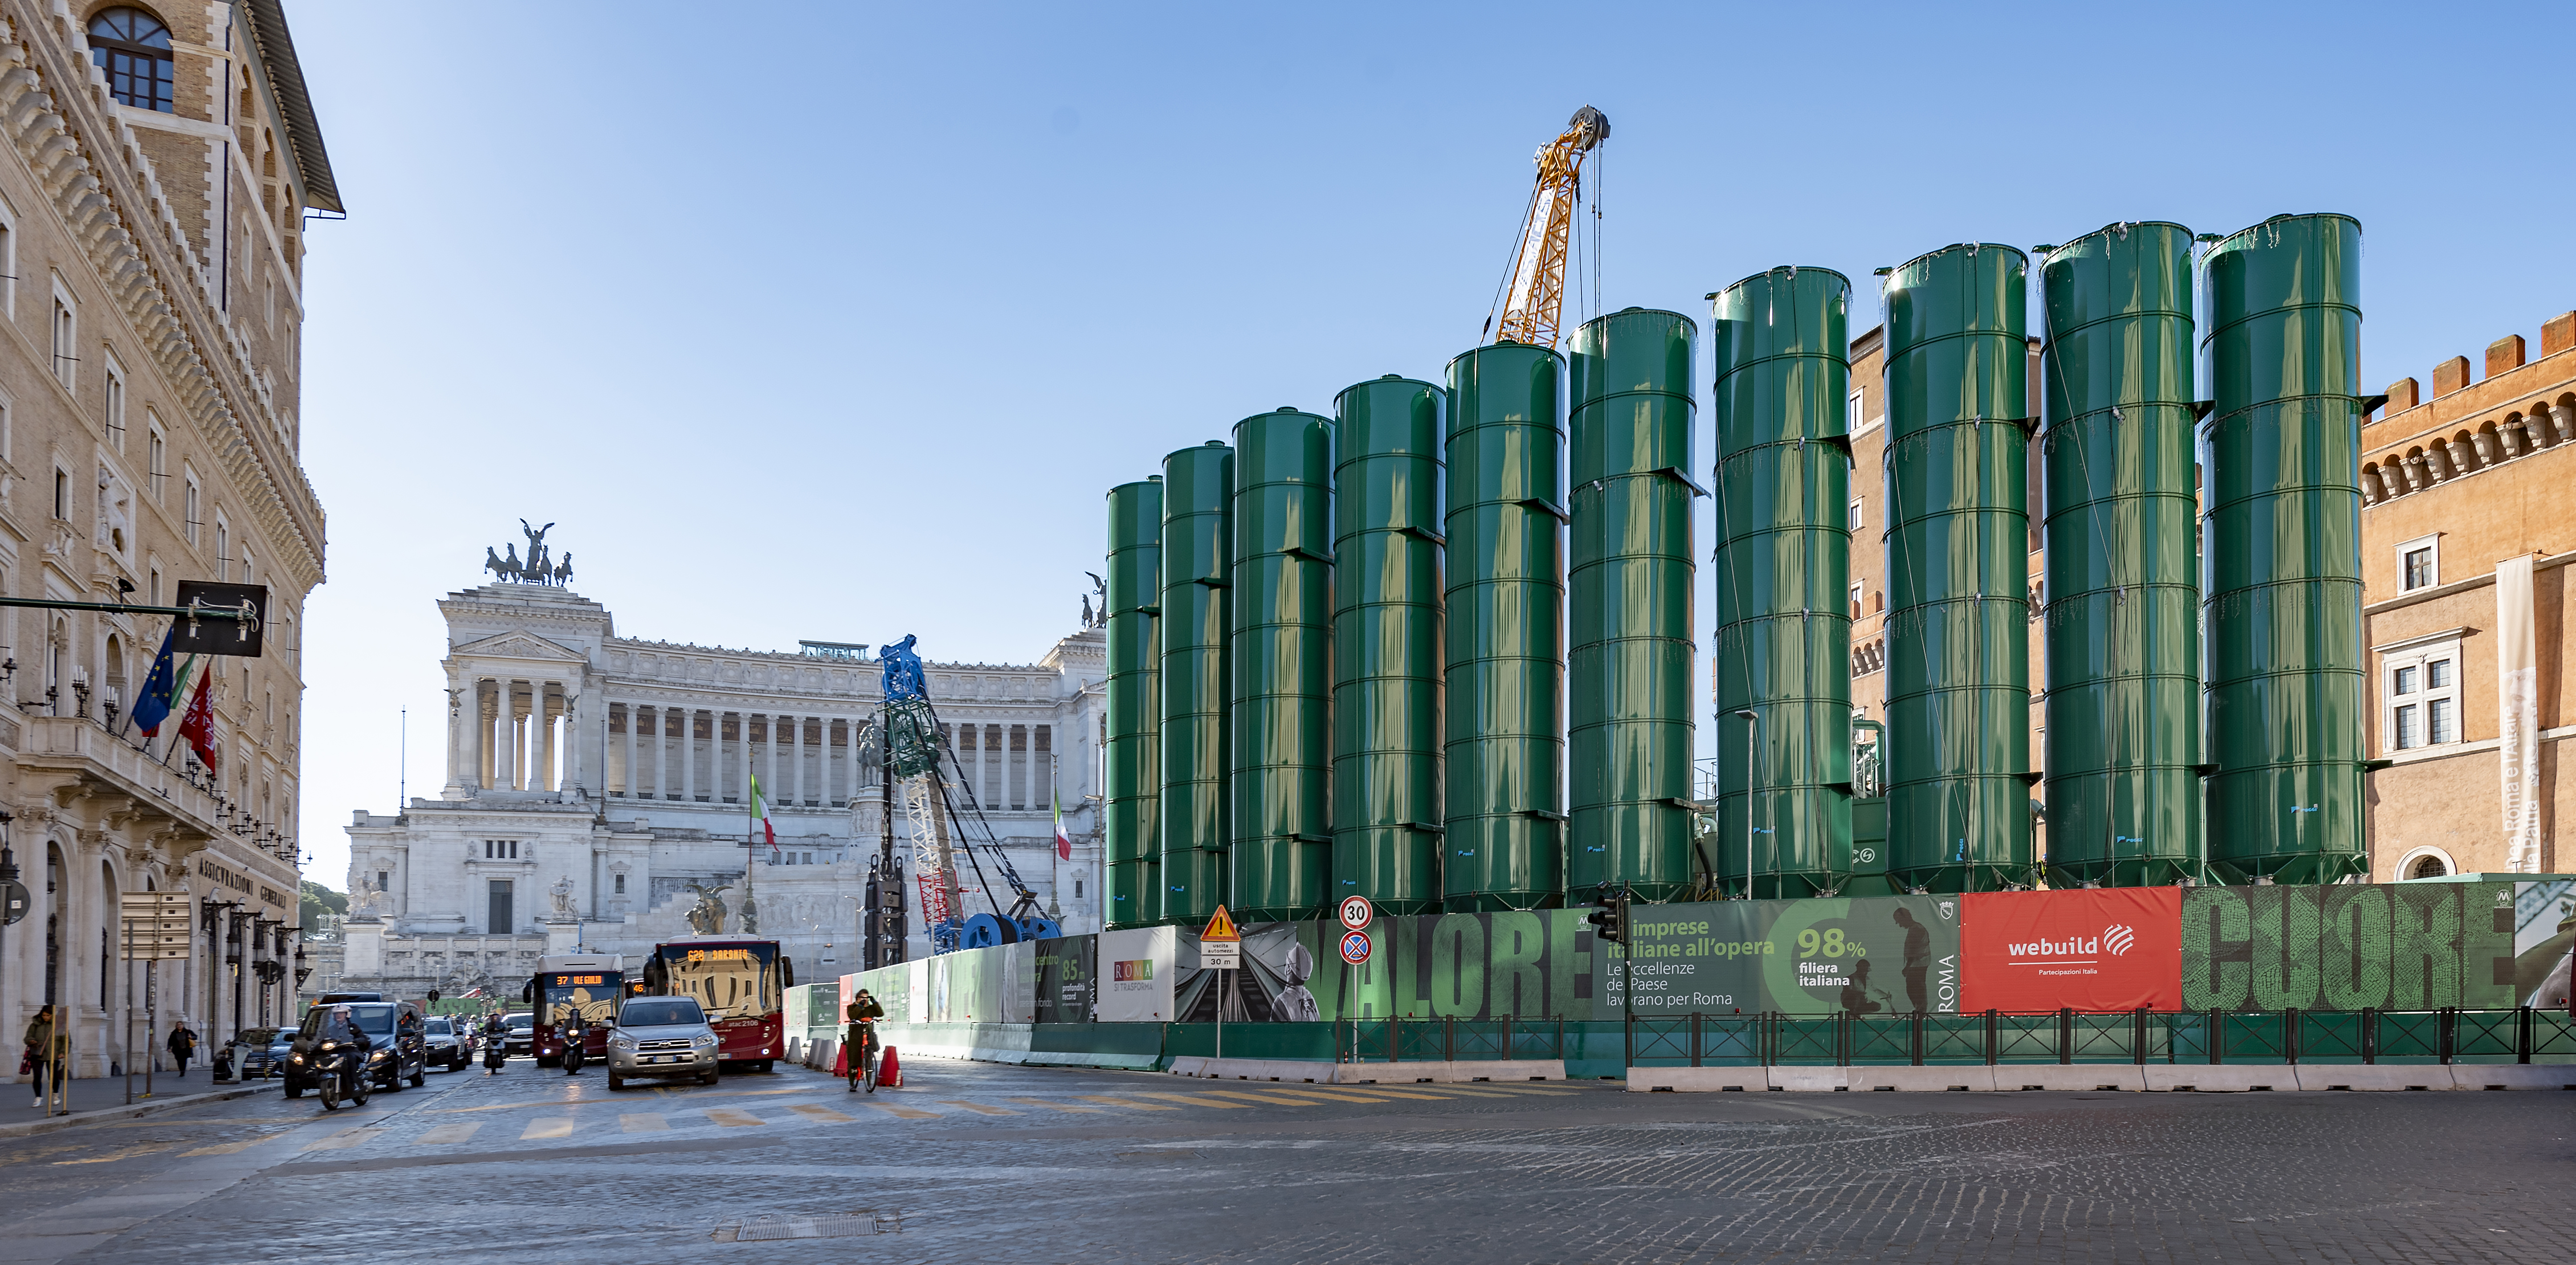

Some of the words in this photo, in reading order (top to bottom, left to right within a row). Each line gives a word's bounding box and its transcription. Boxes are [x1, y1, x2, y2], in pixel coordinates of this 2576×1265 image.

[2506, 766, 2519, 778] e
[2505, 782, 2520, 831] Roma
[2523, 800, 2538, 849] Patria
[2505, 835, 2521, 869] Dea
[2523, 853, 2539, 872] lla
[199, 857, 253, 896] ASSICVRAZIONI
[260, 885, 286, 909] GENERALI
[1347, 906, 1365, 920] 30
[1633, 919, 1709, 940] imprese
[1685, 938, 1774, 960] all'opera
[1798, 928, 1866, 958] 98%
[2009, 937, 2097, 956] webuild
[2183, 883, 2515, 1010] CUORE
[688, 950, 704, 961] 628
[713, 949, 748, 960] BARONIO
[1035, 954, 1059, 966] centro
[1062, 959, 1078, 980] 85
[1079, 971, 1085, 980] m
[1116, 963, 1151, 978] ROMA
[1296, 908, 1592, 1021] VALORE
[1607, 963, 1621, 976] Le
[1630, 962, 1695, 975] ccellenze
[1799, 962, 1837, 973] filiera
[557, 976, 568, 985] 37
[633, 984, 644, 992] 46
[1114, 983, 1119, 992] SI
[1120, 983, 1153, 991] TRASFORMA
[1607, 978, 1625, 991] de
[1631, 978, 1667, 991] Paese
[1800, 975, 1850, 986] italiana
[1939, 954, 1954, 1013] ROMA
[1062, 983, 1085, 994] profondità
[1062, 992, 1077, 1000] record
[1038, 998, 1052, 1007] fondo
[1607, 993, 1663, 1006] lavrano
[1667, 995, 1689, 1009] per
[1694, 992, 1732, 1005] Roma
